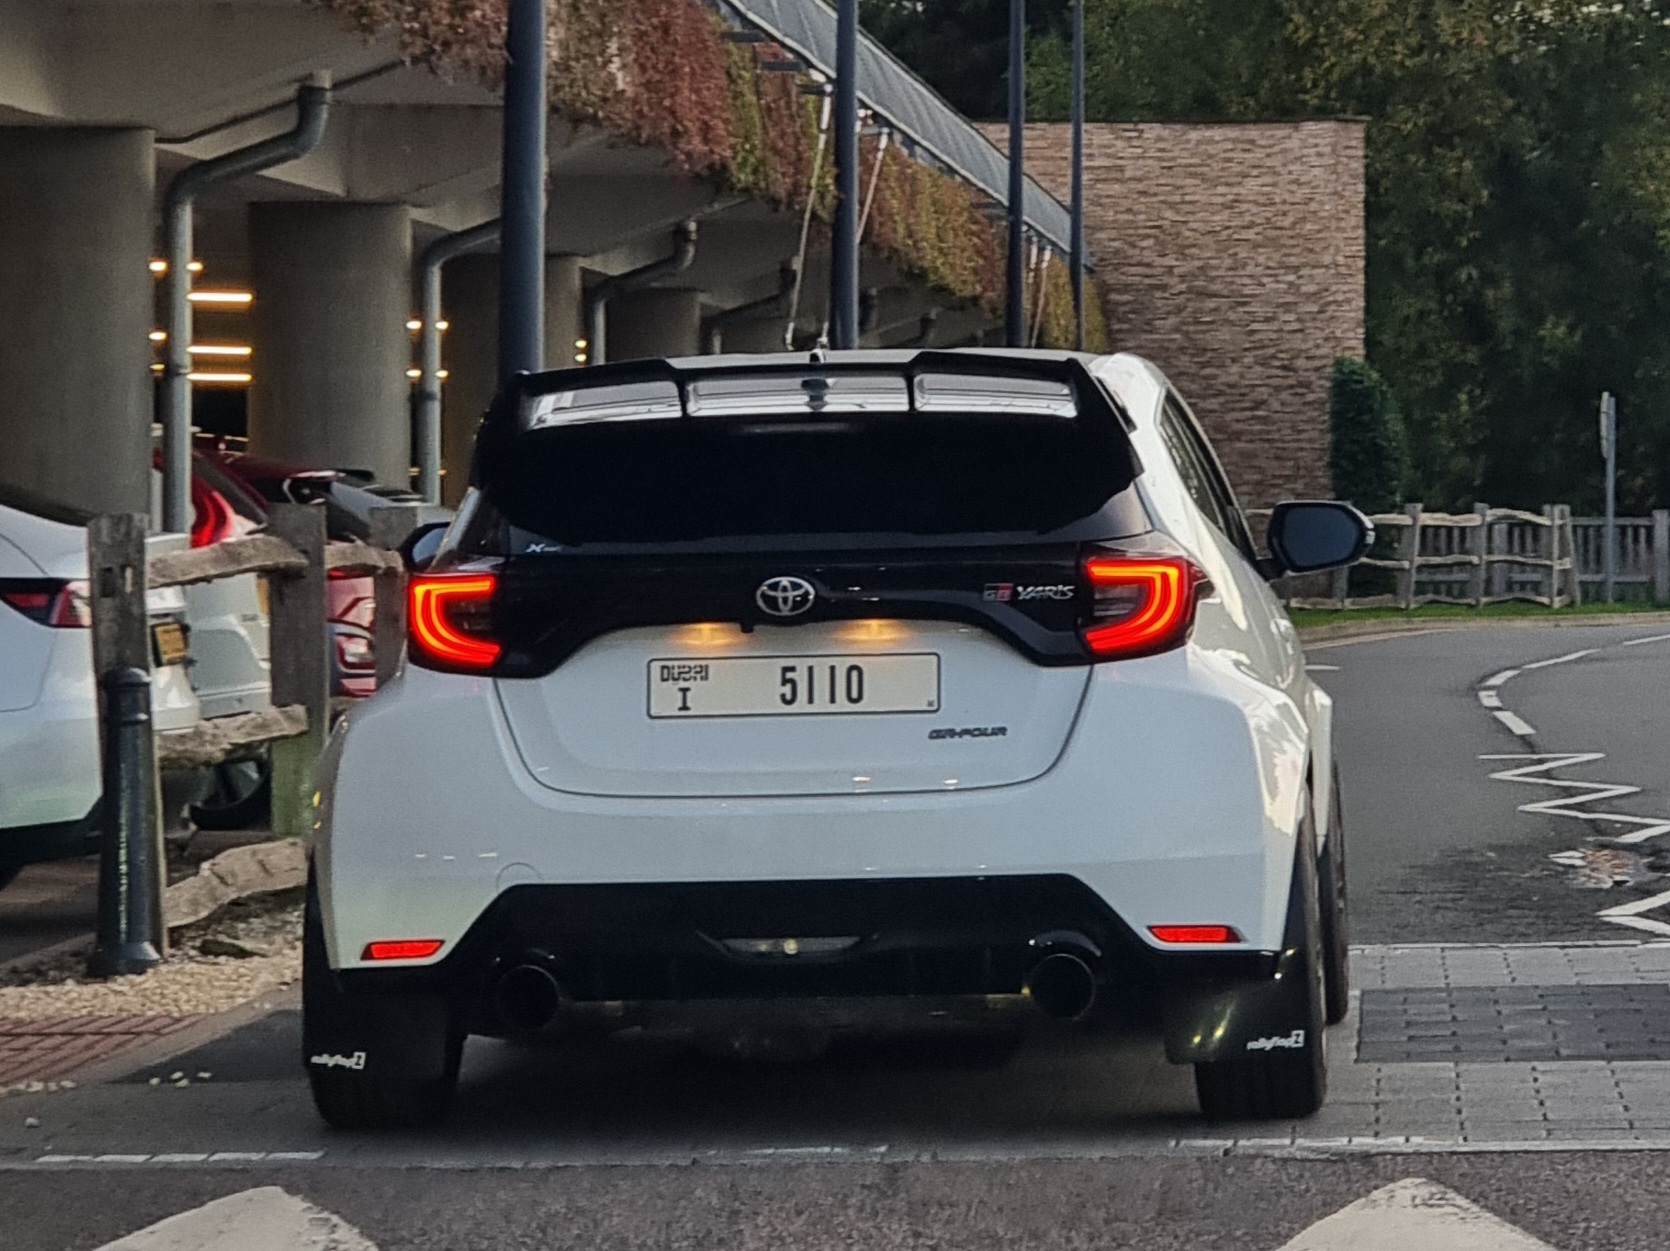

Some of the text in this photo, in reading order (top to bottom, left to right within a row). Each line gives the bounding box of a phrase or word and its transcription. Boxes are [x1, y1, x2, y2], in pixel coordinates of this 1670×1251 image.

[1016, 584, 1075, 600] YARIS
[780, 664, 864, 706] 5110
[677, 687, 692, 711] I
